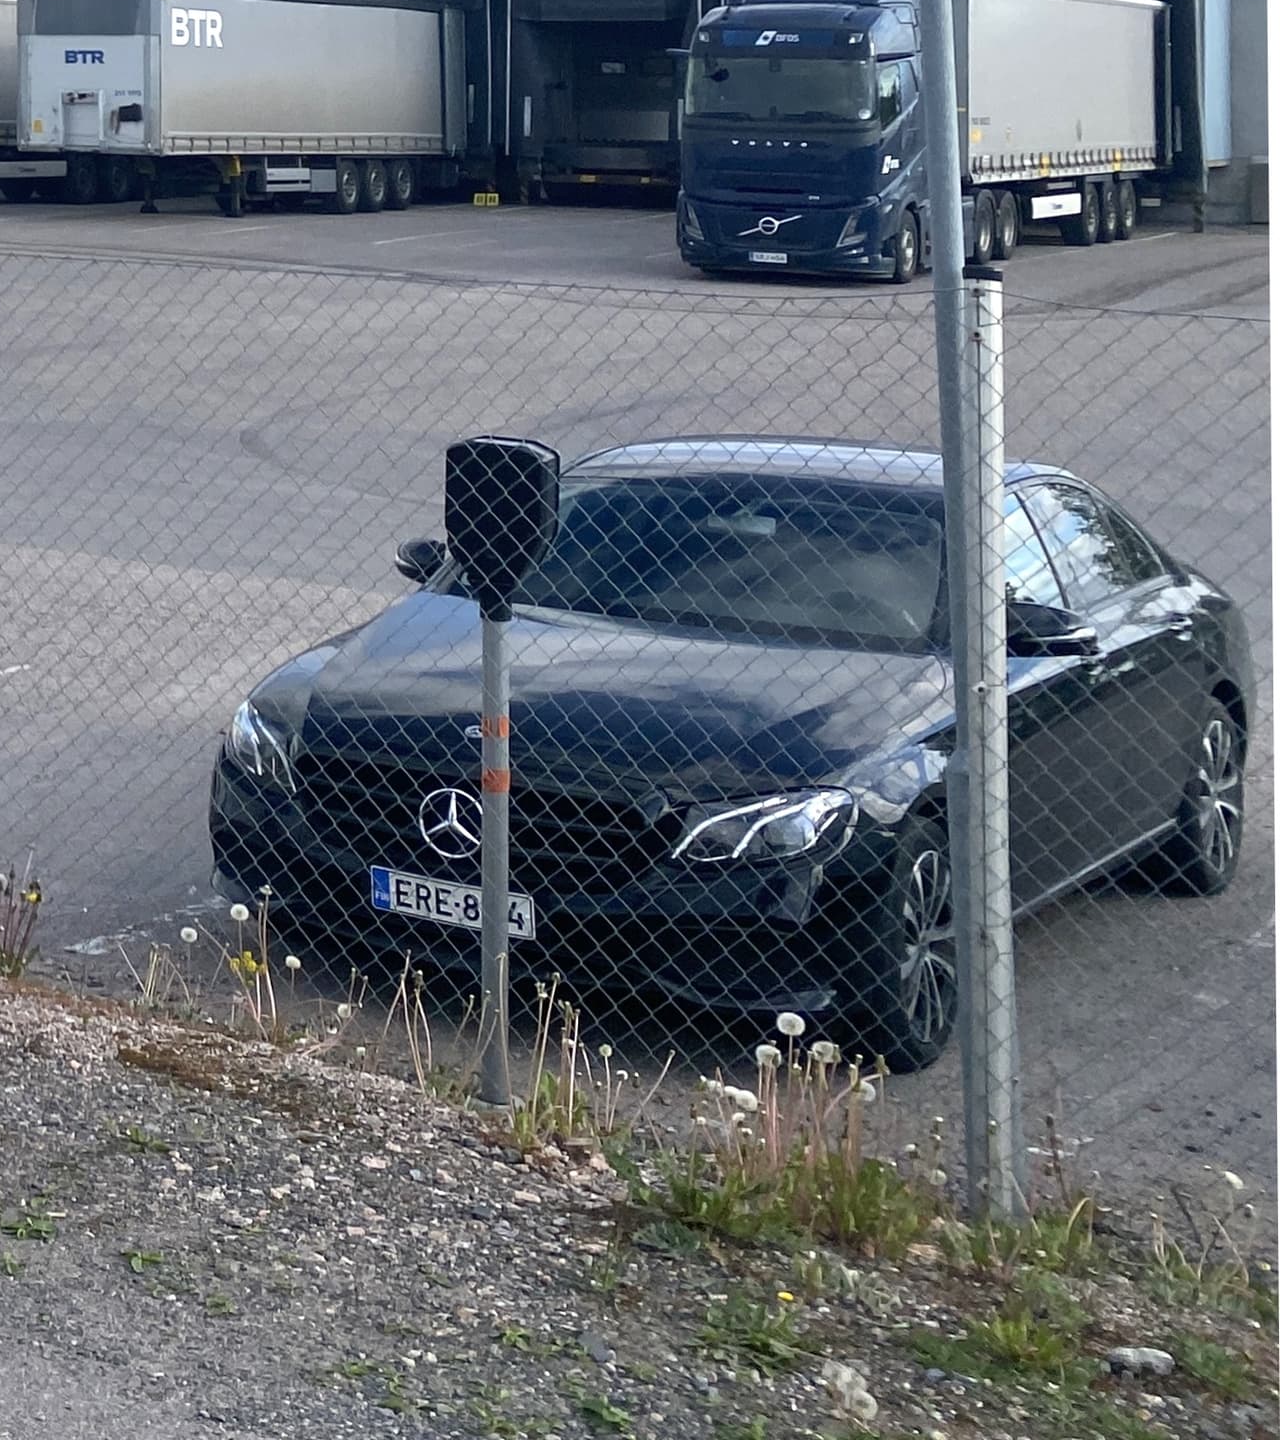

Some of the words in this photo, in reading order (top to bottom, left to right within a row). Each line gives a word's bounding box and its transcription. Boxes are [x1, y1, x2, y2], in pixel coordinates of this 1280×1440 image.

[171, 7, 224, 49] BTR
[64, 50, 105, 64] BTR
[731, 139, 808, 148] VOLVO
[395, 878, 525, 931] ERE-84
